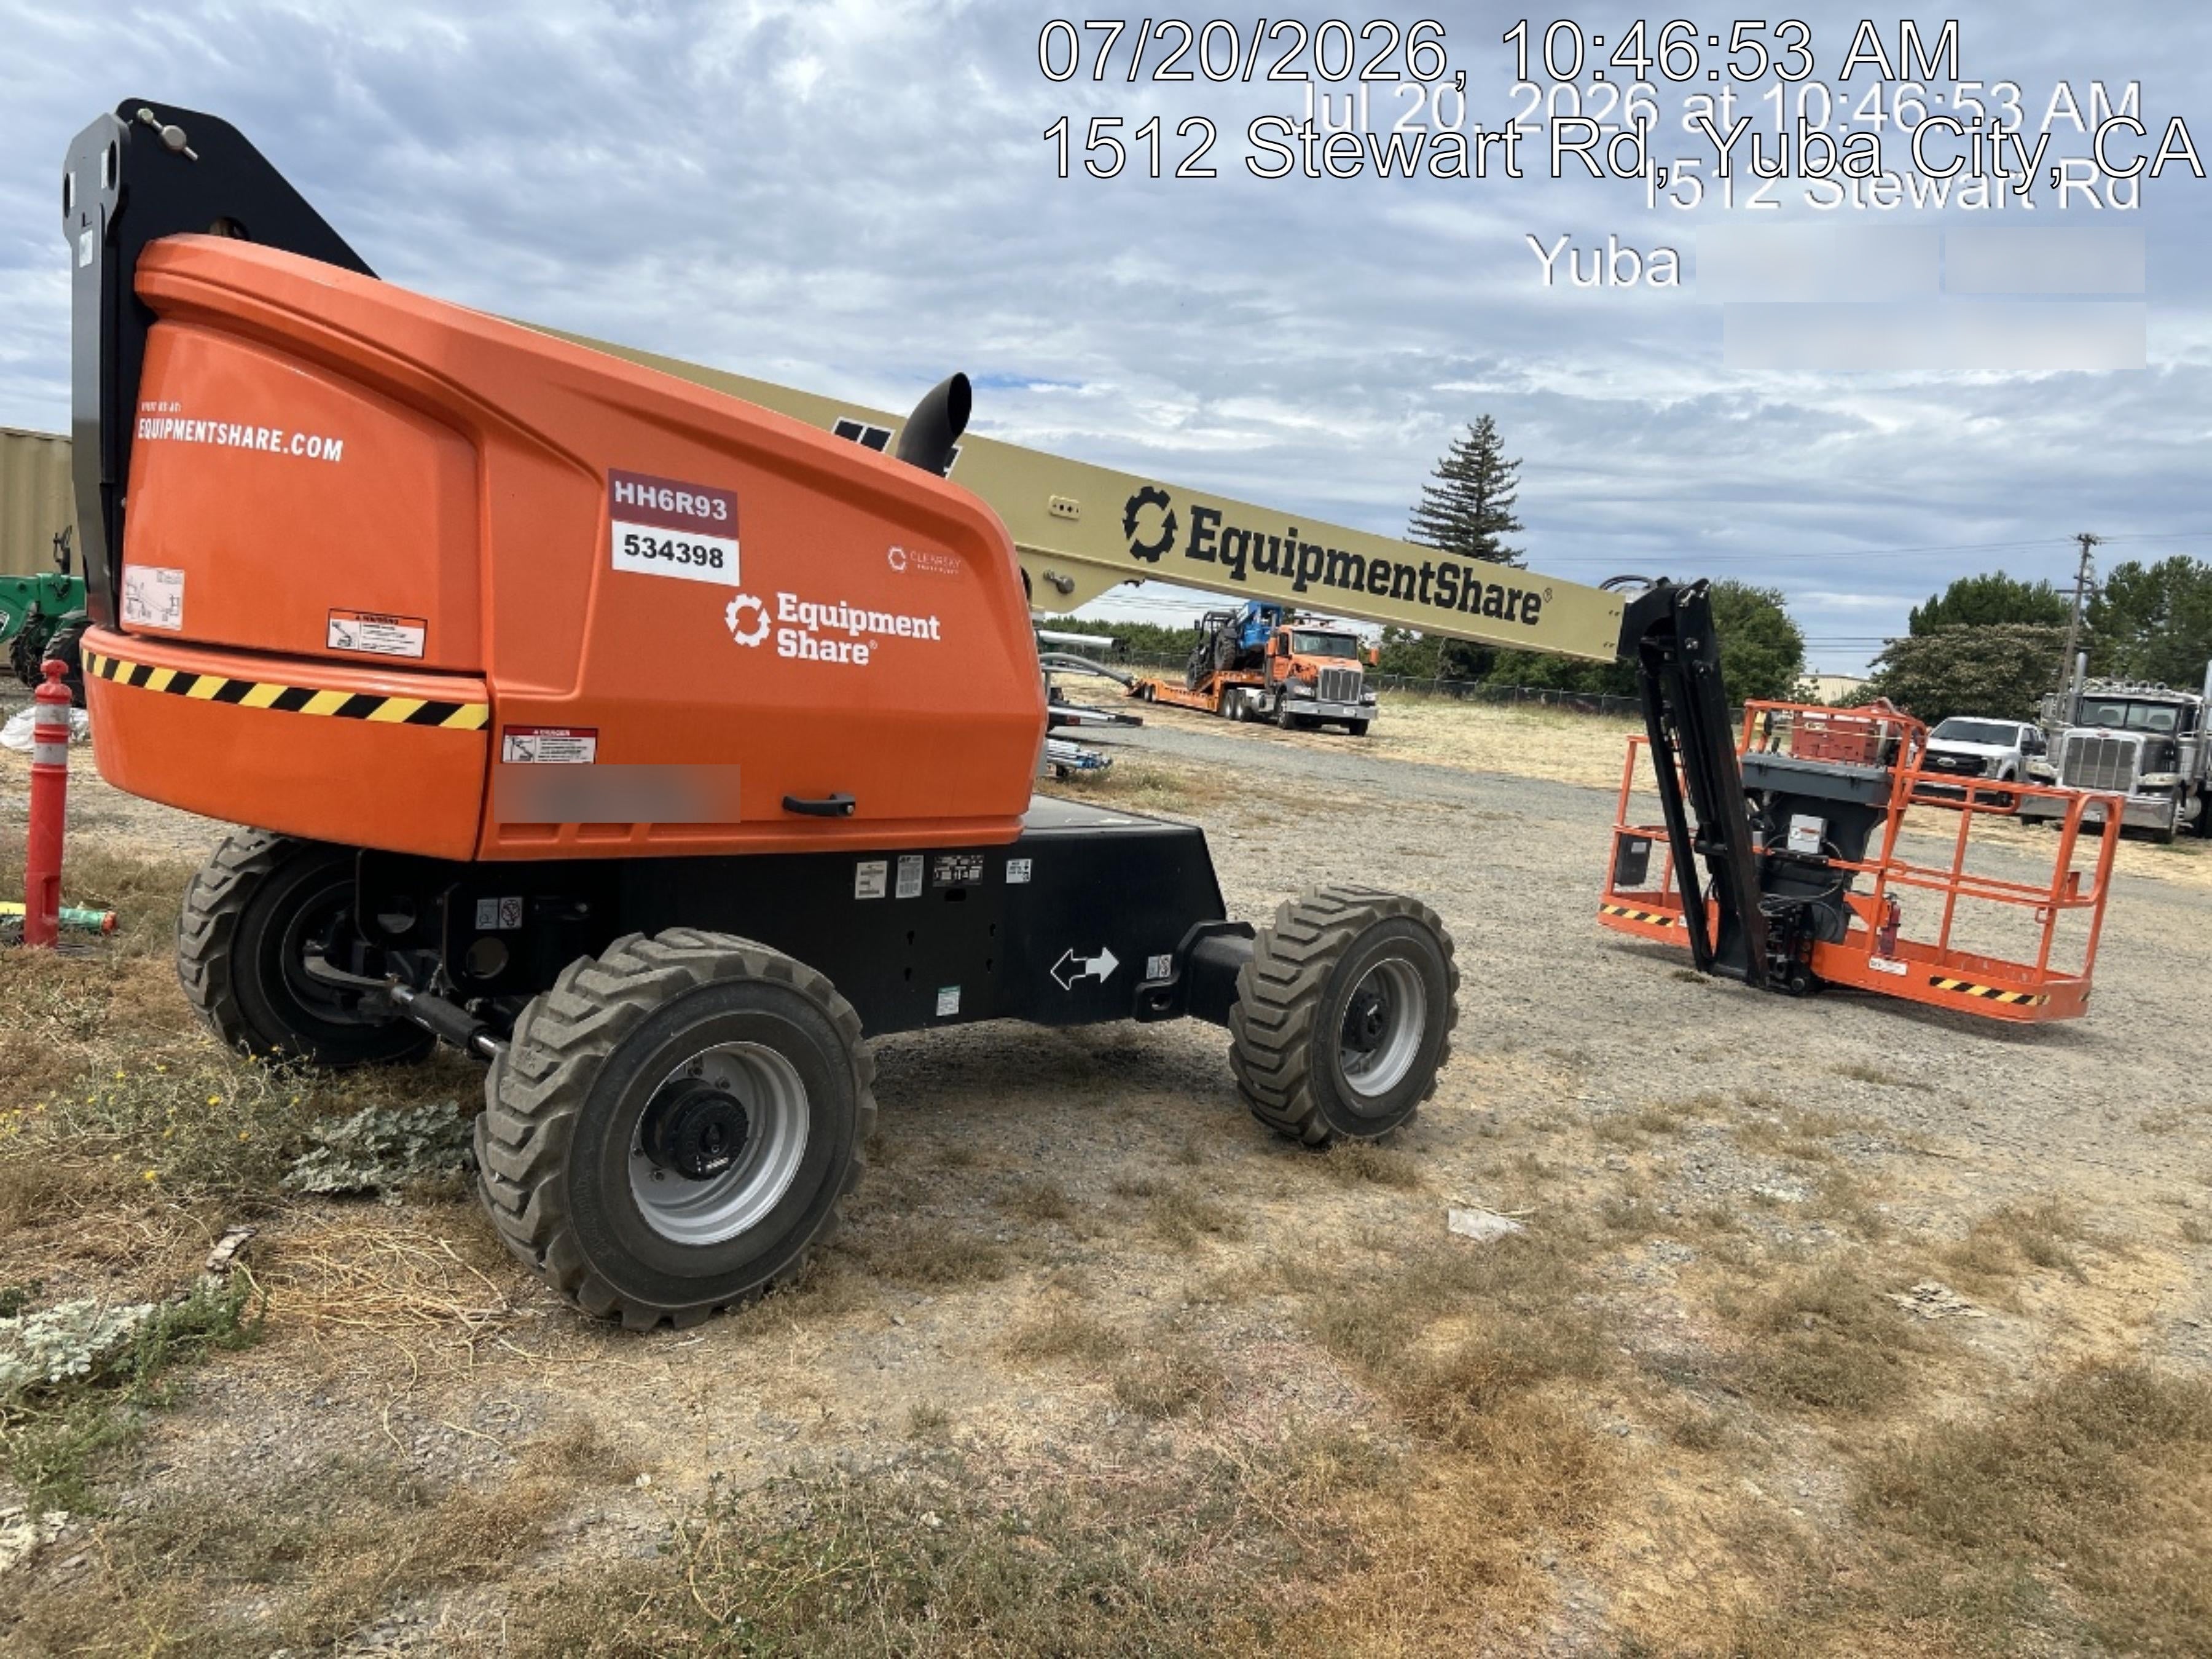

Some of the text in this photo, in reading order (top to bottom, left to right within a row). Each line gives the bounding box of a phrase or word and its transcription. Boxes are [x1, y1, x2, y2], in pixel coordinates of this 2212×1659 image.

[138, 418, 343, 461] EQUIPMENTSHARE.COM
[615, 480, 728, 520] HH6R93
[624, 534, 724, 568] 534398
[777, 592, 941, 641] Equipment
